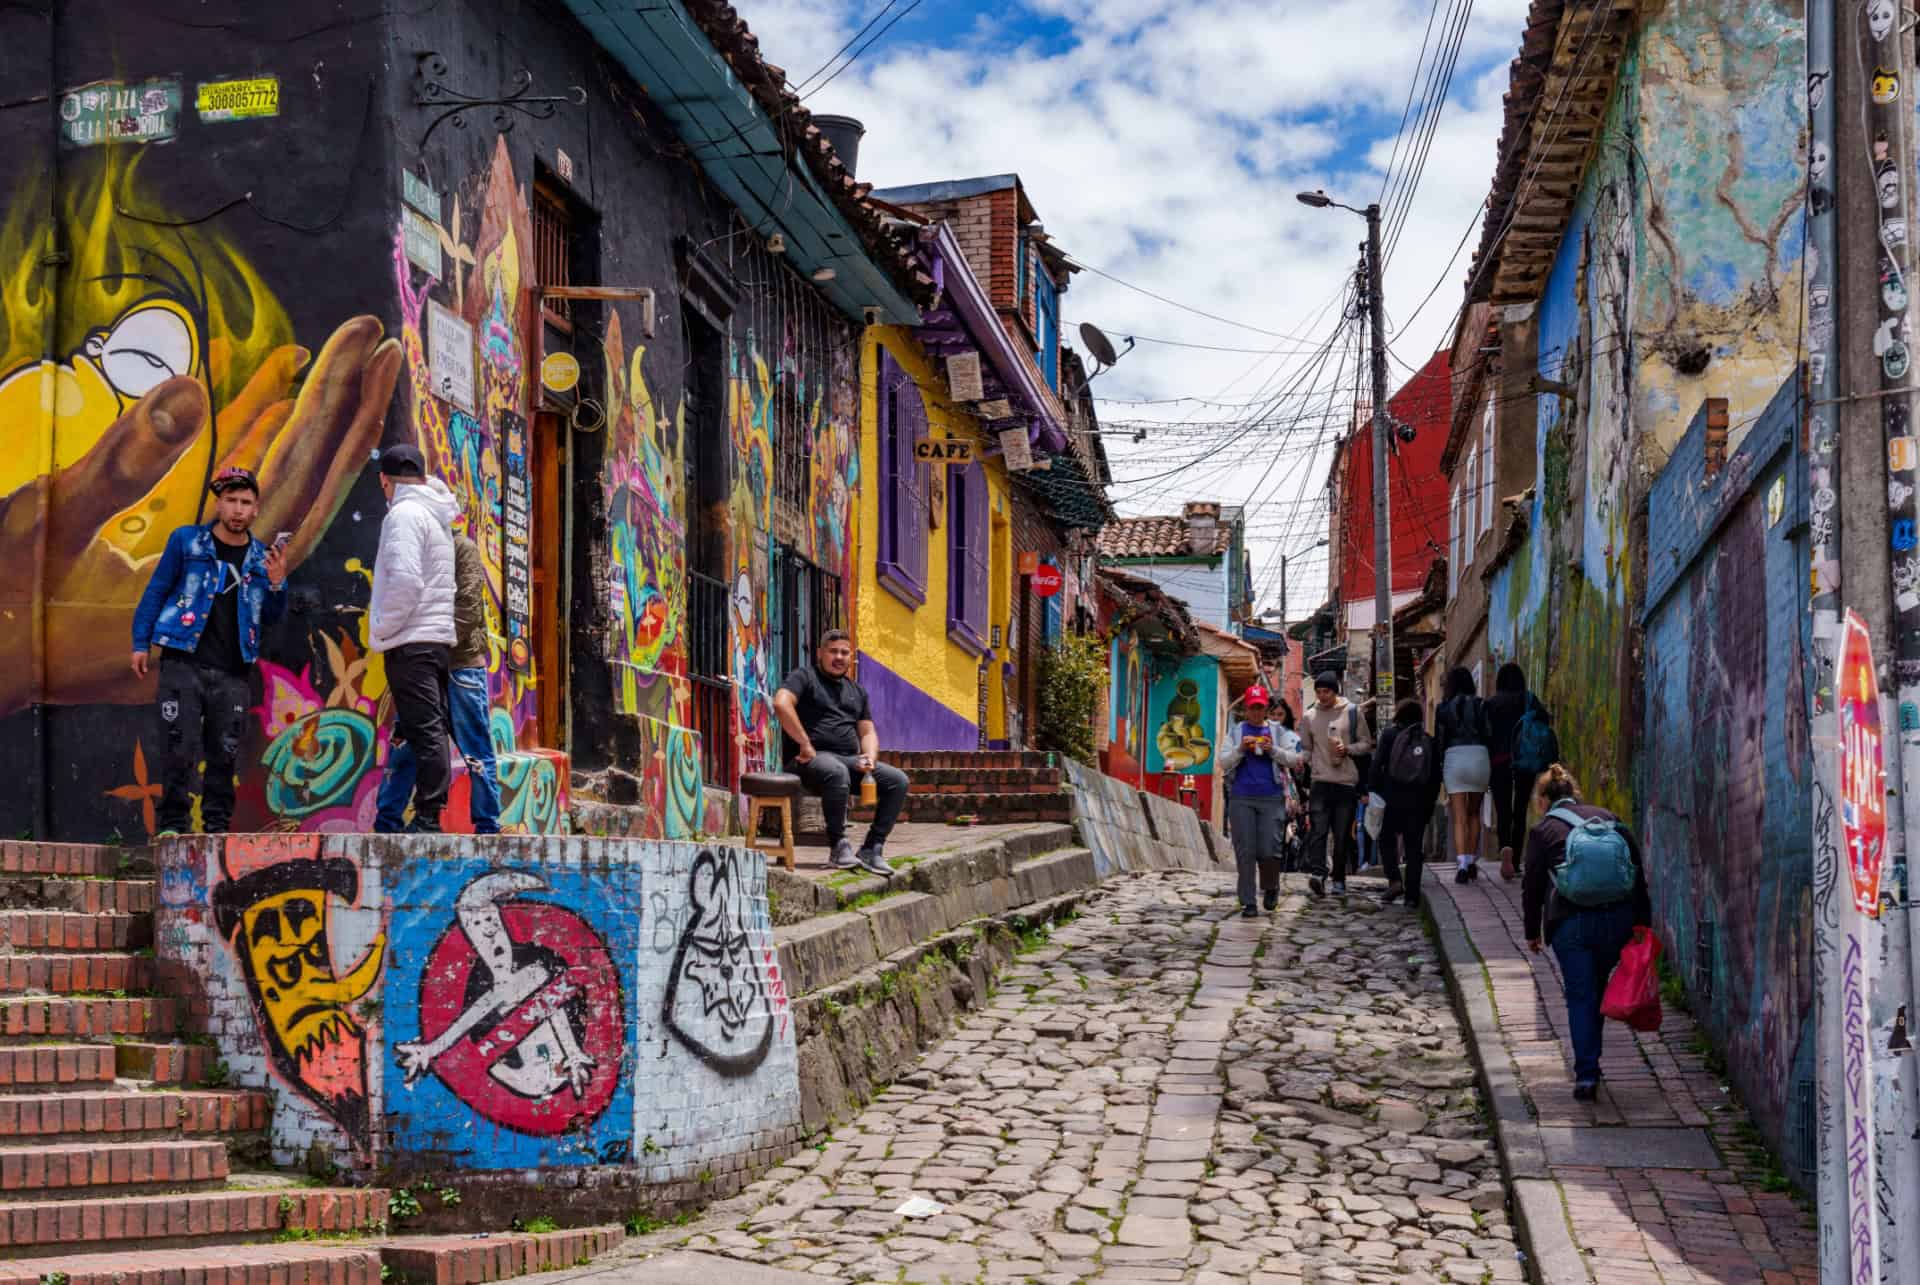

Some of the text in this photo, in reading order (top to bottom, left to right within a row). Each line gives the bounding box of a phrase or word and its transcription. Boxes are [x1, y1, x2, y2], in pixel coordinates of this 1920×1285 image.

[101, 89, 136, 112] PLAZA
[71, 120, 85, 141] DE
[88, 119, 101, 140] LA
[917, 443, 969, 458] CAFE
